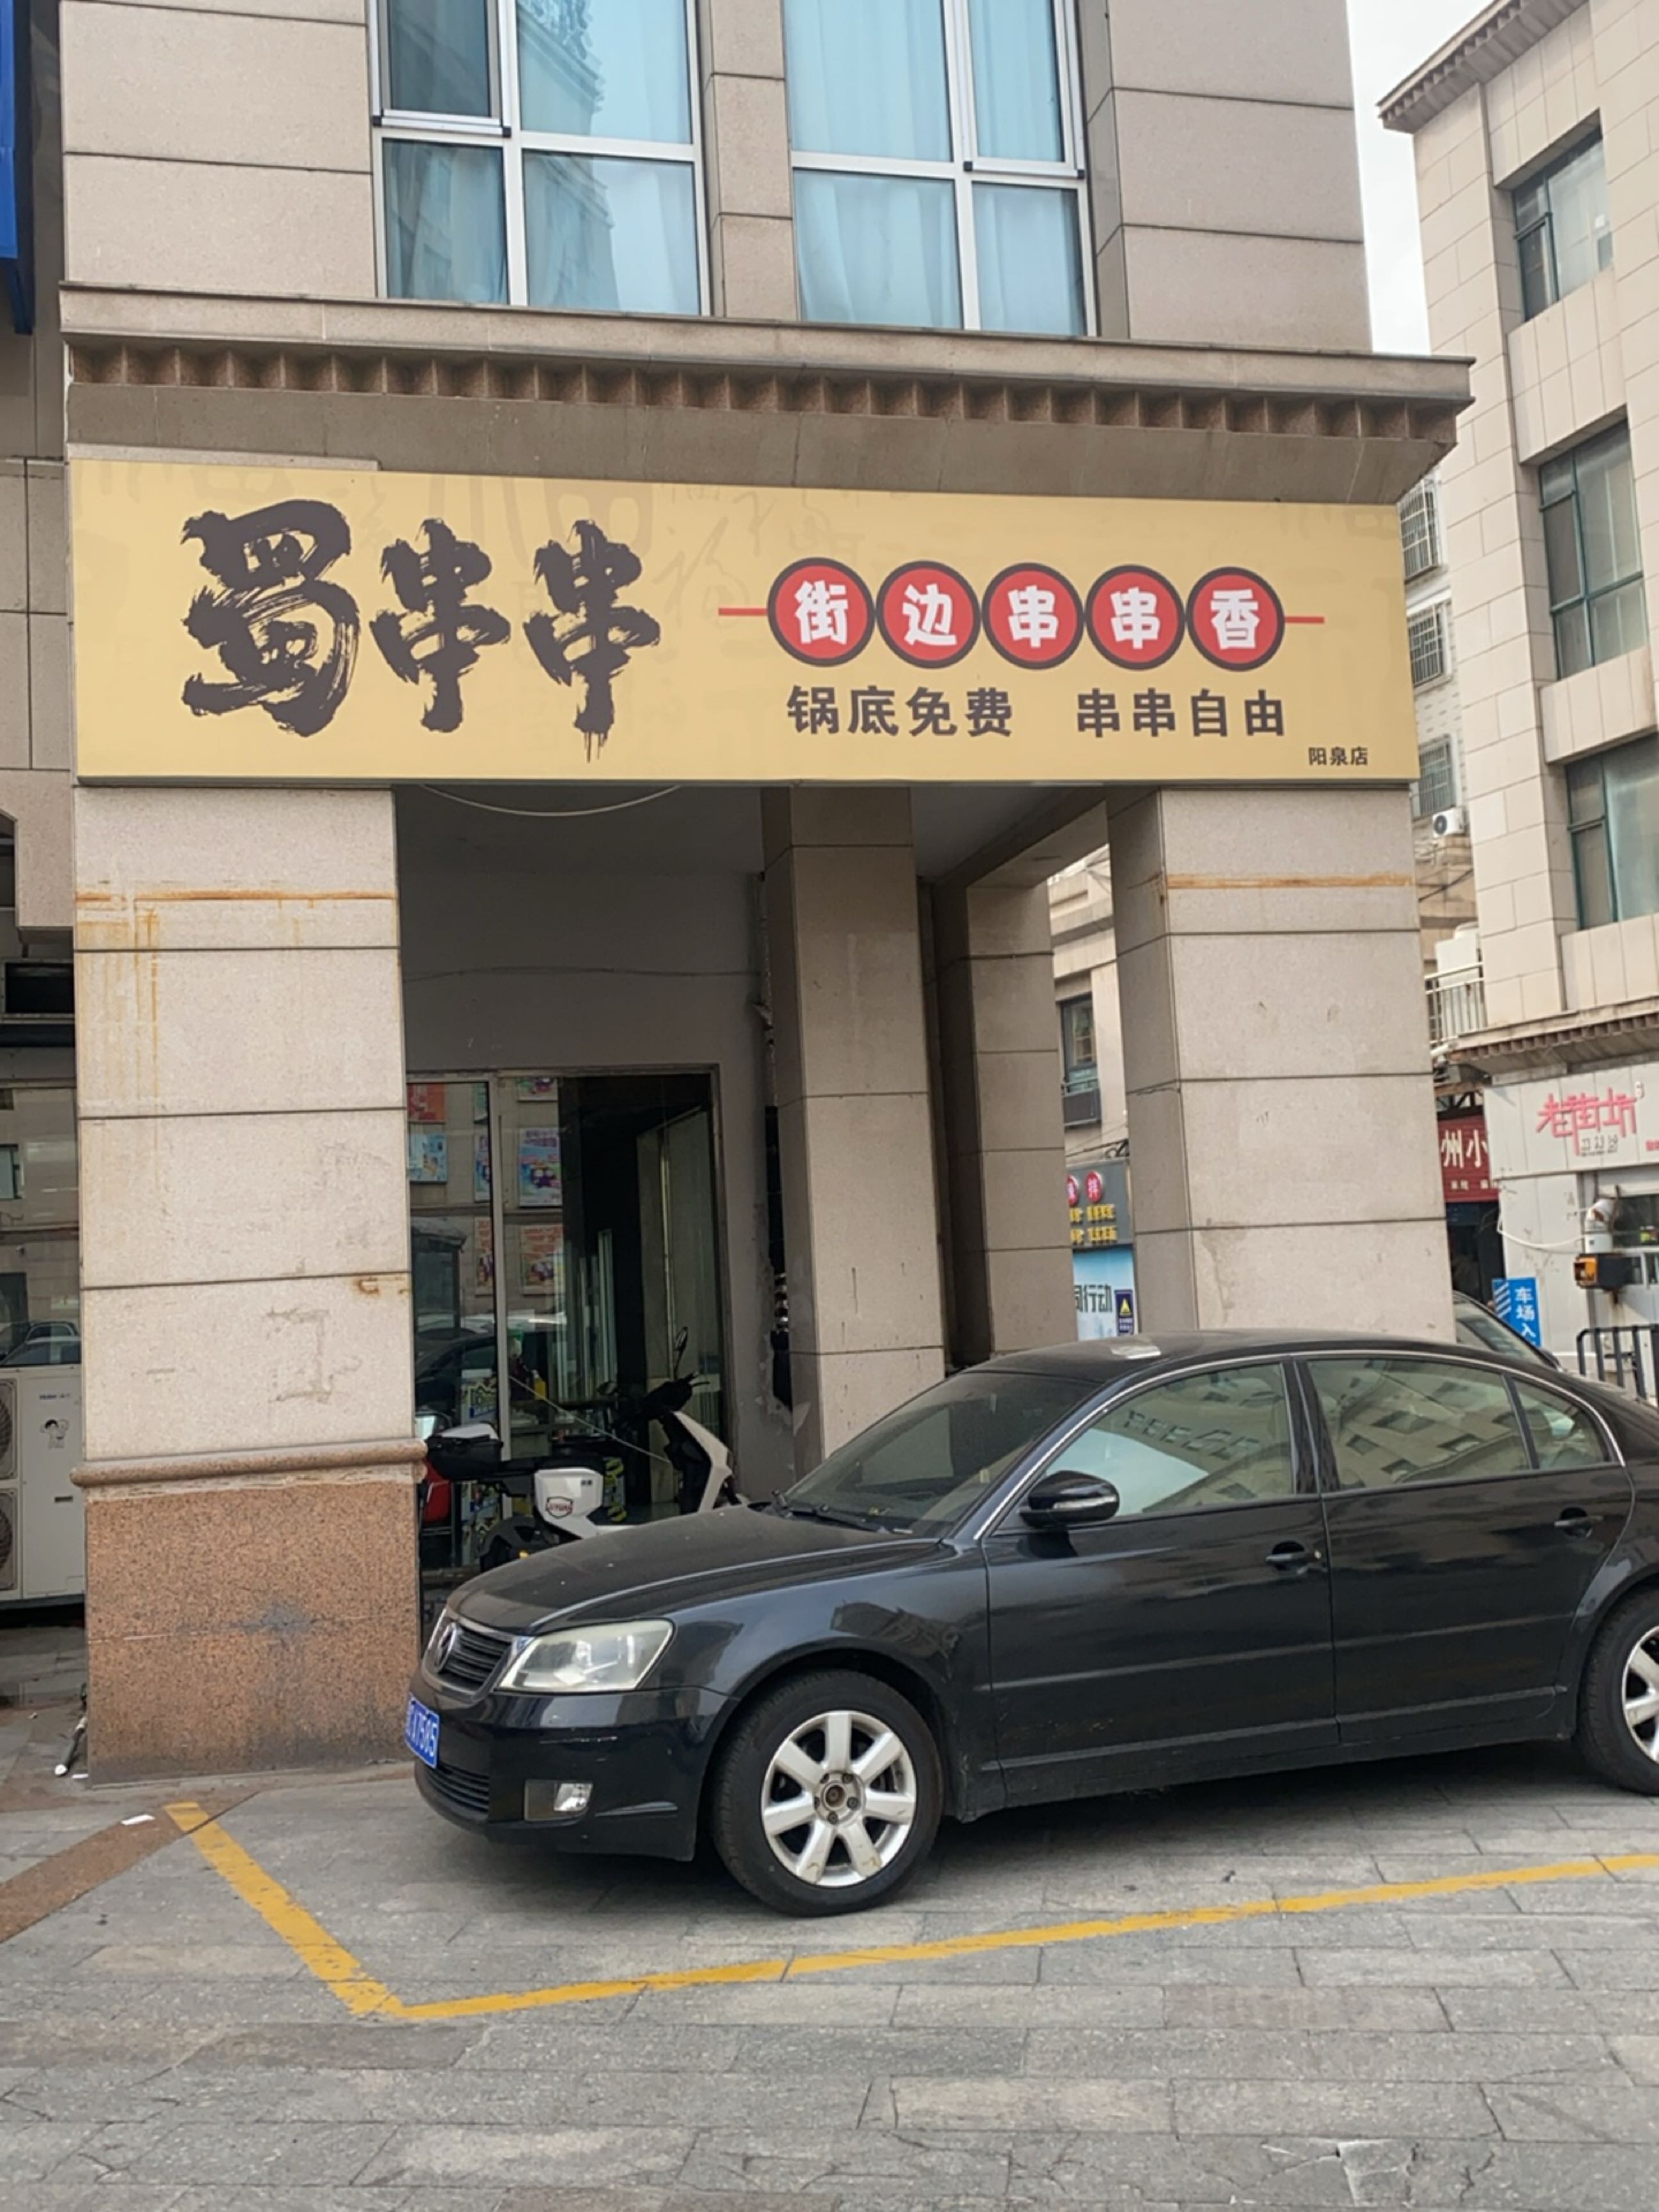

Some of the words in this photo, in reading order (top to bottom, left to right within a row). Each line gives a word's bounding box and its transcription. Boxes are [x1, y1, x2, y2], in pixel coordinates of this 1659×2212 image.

[181, 499, 661, 763] 蜀串串
[794, 579, 1260, 652] 街边串串香
[787, 684, 1013, 737] 锅底免费
[1076, 687, 1285, 738] 串串自由
[1308, 746, 1369, 767] 阳泉店
[1537, 1087, 1638, 1156] 老街坊
[1514, 1286, 1537, 1346] 车场入
